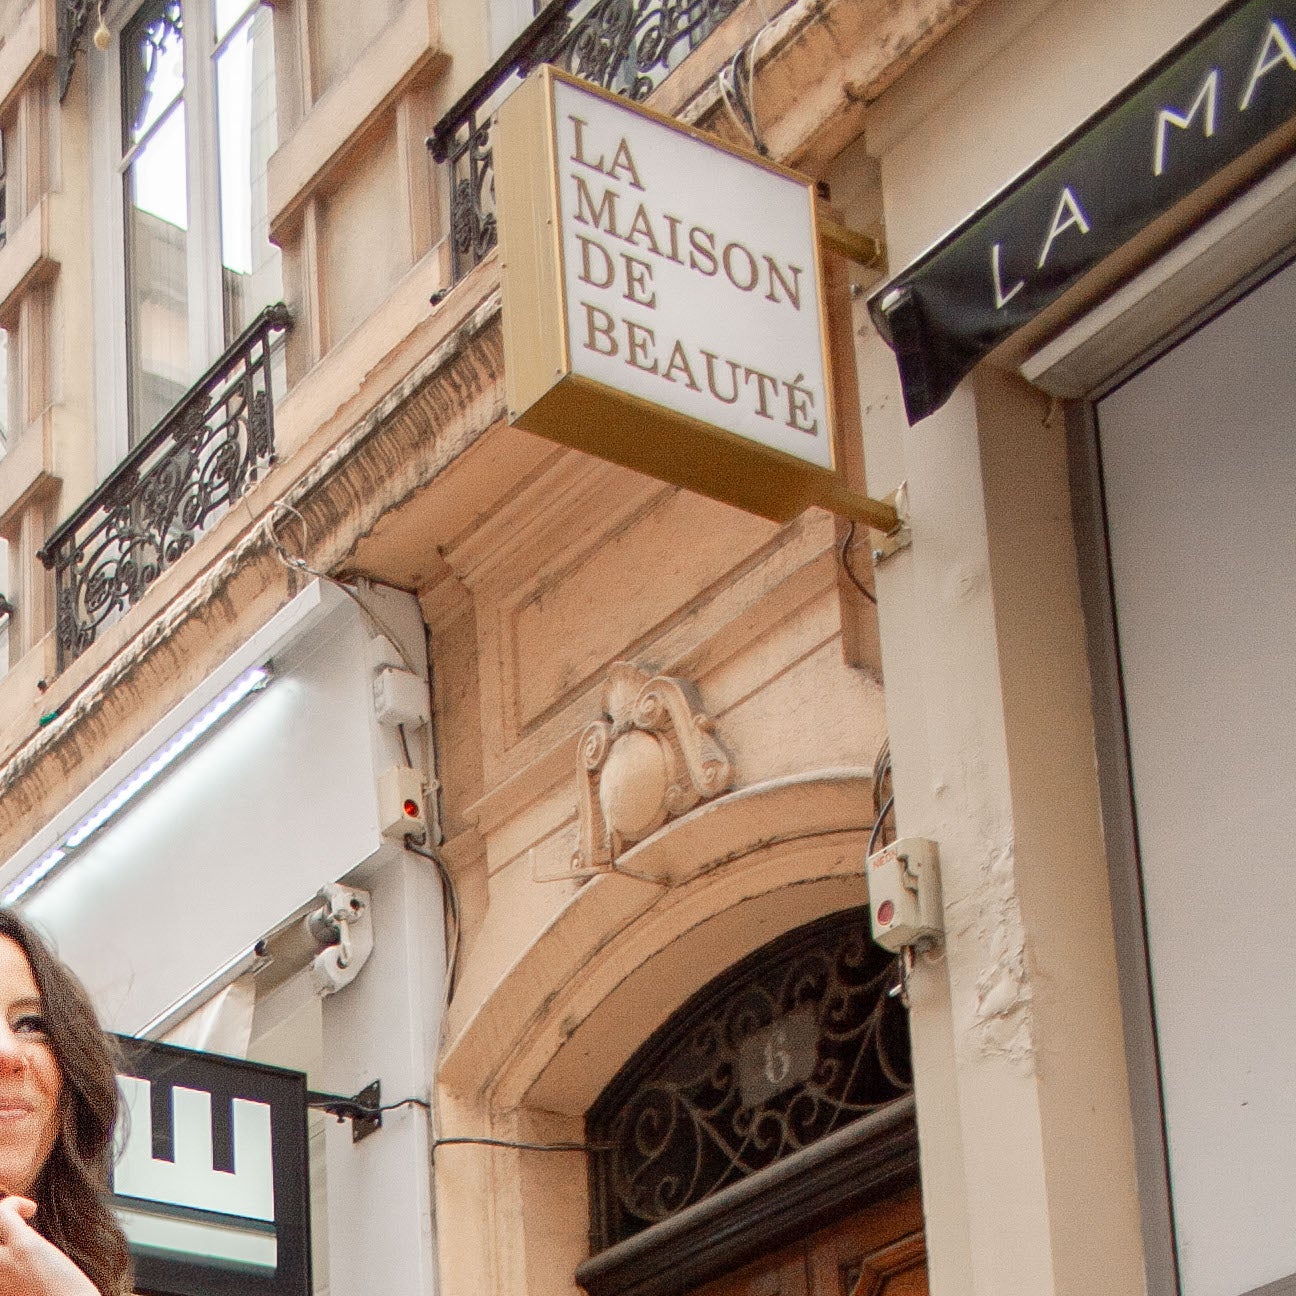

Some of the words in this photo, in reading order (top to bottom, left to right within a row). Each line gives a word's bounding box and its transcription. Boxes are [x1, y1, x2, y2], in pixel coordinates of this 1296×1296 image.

[568, 114, 646, 191] LA
[570, 174, 803, 311] MAISON
[575, 234, 657, 310] DE
[992, 186, 1091, 309] LA
[580, 301, 819, 437] BEAUTÉ
[764, 1028, 790, 1084] 6
